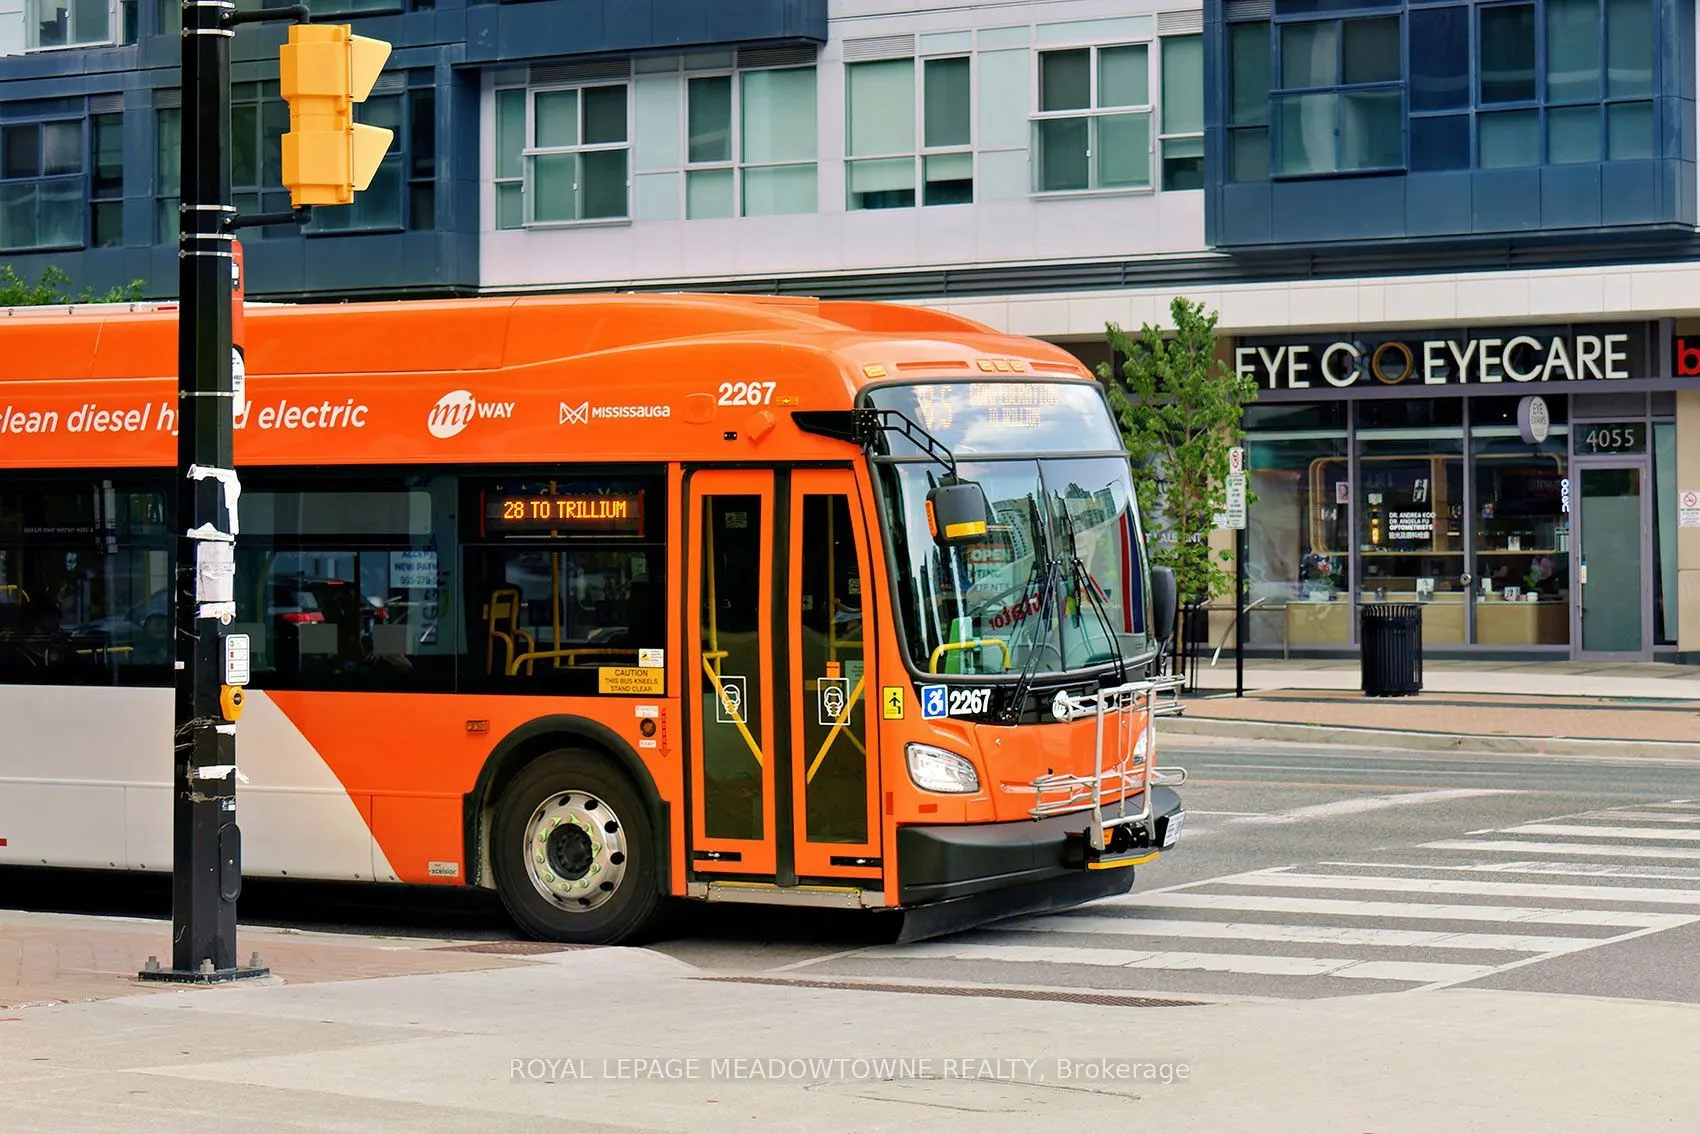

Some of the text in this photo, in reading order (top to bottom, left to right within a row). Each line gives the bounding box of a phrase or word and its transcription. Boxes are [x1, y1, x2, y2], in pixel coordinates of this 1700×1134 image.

[1423, 334, 1629, 385] EYECARE
[717, 382, 777, 407] 2267
[67, 402, 152, 433] diesel
[257, 399, 369, 430] electric
[477, 402, 515, 418] WAY
[1586, 428, 1635, 448] 4055
[503, 500, 627, 519] 28 TO TRILLIUM
[614, 669, 648, 677] CAUTION
[949, 688, 991, 715] 2267
